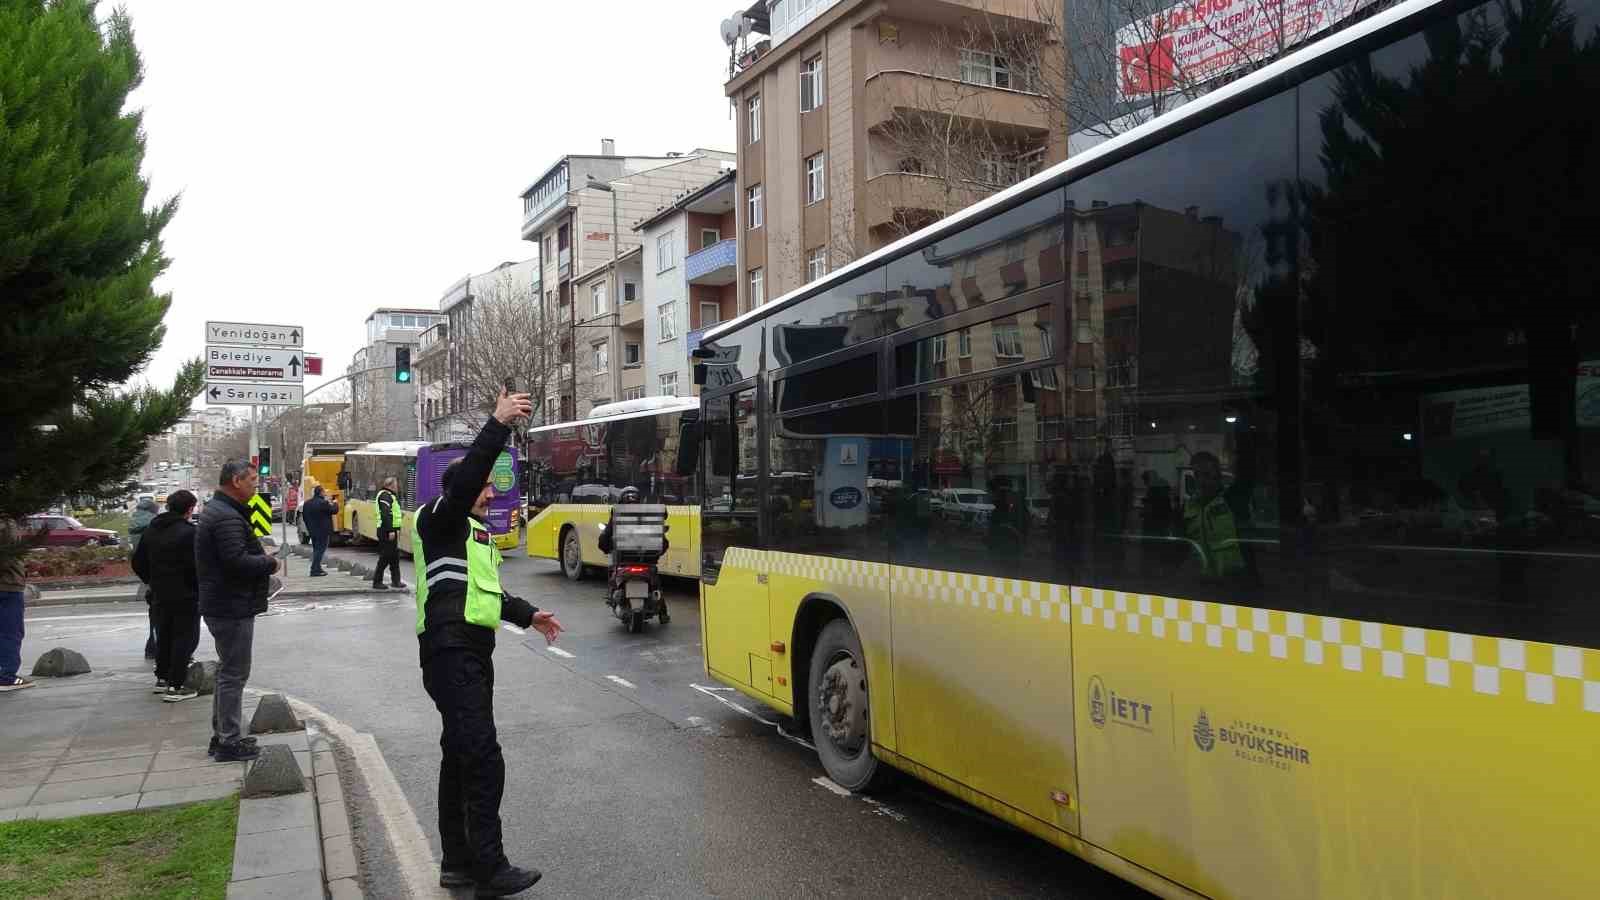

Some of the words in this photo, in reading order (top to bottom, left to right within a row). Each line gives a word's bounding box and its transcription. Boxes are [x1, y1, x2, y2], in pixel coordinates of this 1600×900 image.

[1220, 6, 1255, 31] KERİM
[212, 327, 286, 341] Yenidoğan
[211, 351, 272, 363] Belediye
[1110, 691, 1152, 725] İETT
[1219, 727, 1311, 765] BÜYÜKŞEHİR
